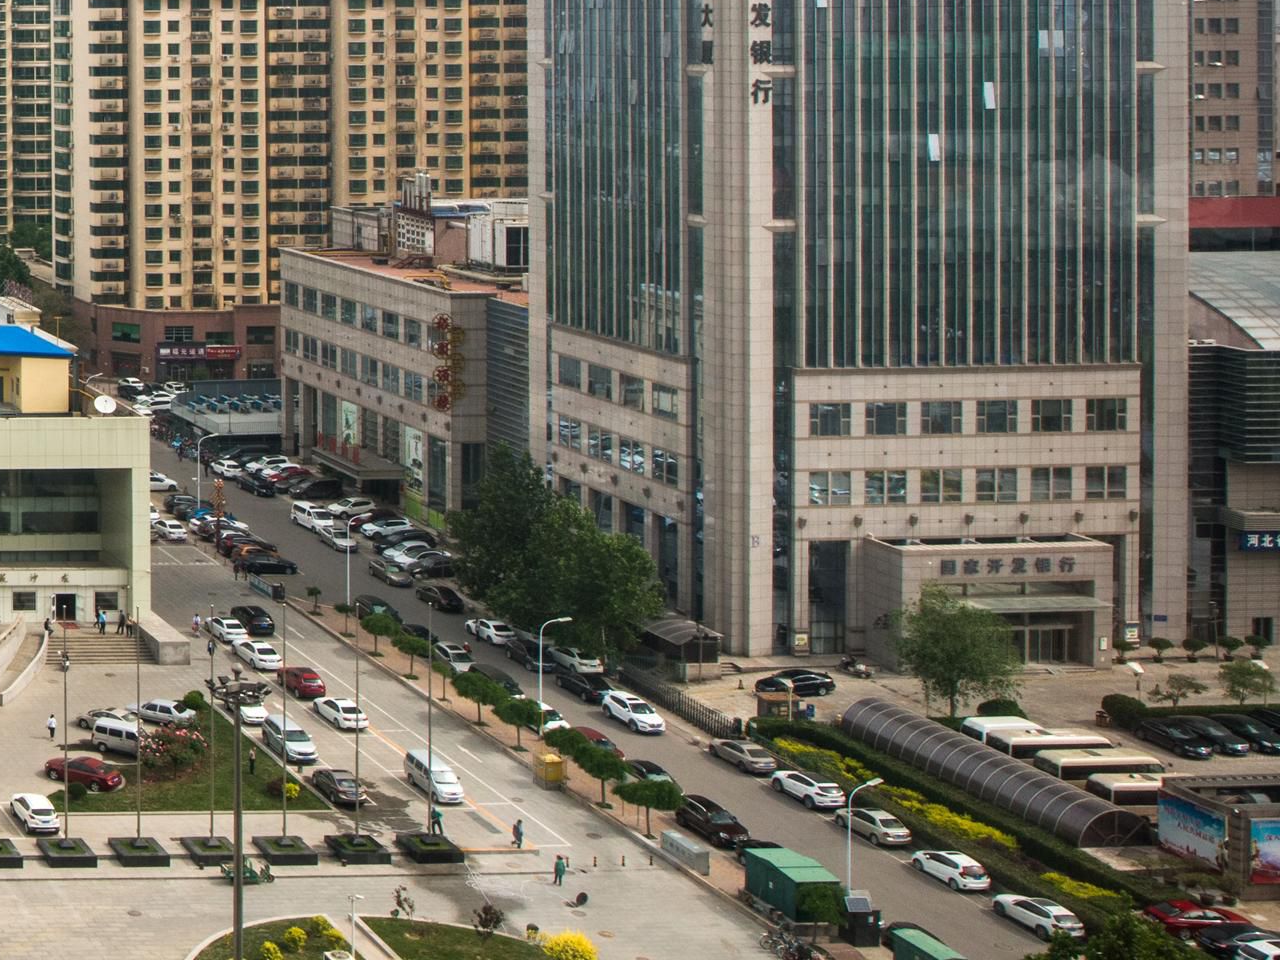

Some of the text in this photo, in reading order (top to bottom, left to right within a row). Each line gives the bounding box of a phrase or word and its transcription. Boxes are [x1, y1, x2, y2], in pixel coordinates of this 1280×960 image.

[941, 556, 1075, 576] 国家开发银行
